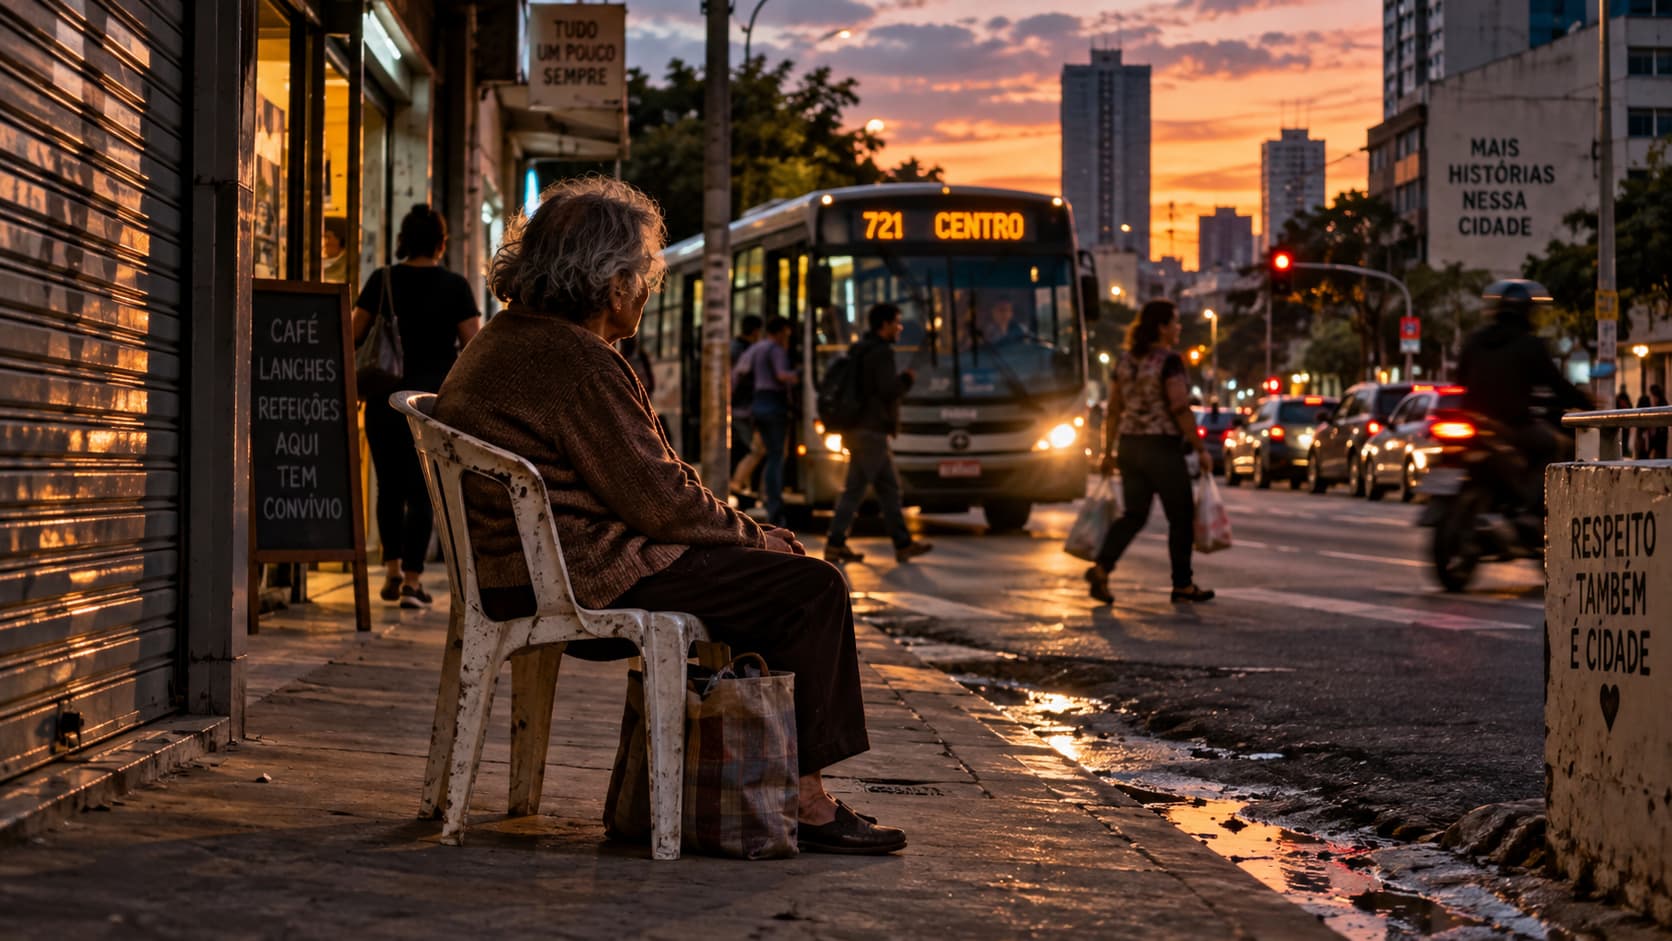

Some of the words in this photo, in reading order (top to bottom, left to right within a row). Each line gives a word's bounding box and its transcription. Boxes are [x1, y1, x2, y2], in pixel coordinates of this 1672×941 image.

[553, 20, 598, 38] TUDO
[537, 44, 560, 61] UM
[566, 44, 616, 62] POUCO
[543, 67, 608, 85] SEMPRE
[1471, 138, 1520, 157] MAIS
[1449, 160, 1555, 184] HISTÓRIAS
[1463, 191, 1527, 210] NESSA
[863, 211, 904, 240] 721
[934, 211, 1025, 241] CENTRO
[1458, 217, 1532, 236] CIDADE
[271, 313, 319, 344] CAFÉ
[259, 357, 336, 382] LANCHES
[258, 393, 340, 424] REFEIÇÕES
[275, 432, 319, 456] AQUI
[277, 465, 317, 488] TEM
[263, 494, 343, 520] CONVÍVIO
[1571, 511, 1656, 560] RESPEITO
[1576, 560, 1647, 616] TAMBÉM
[1570, 617, 1580, 670] É
